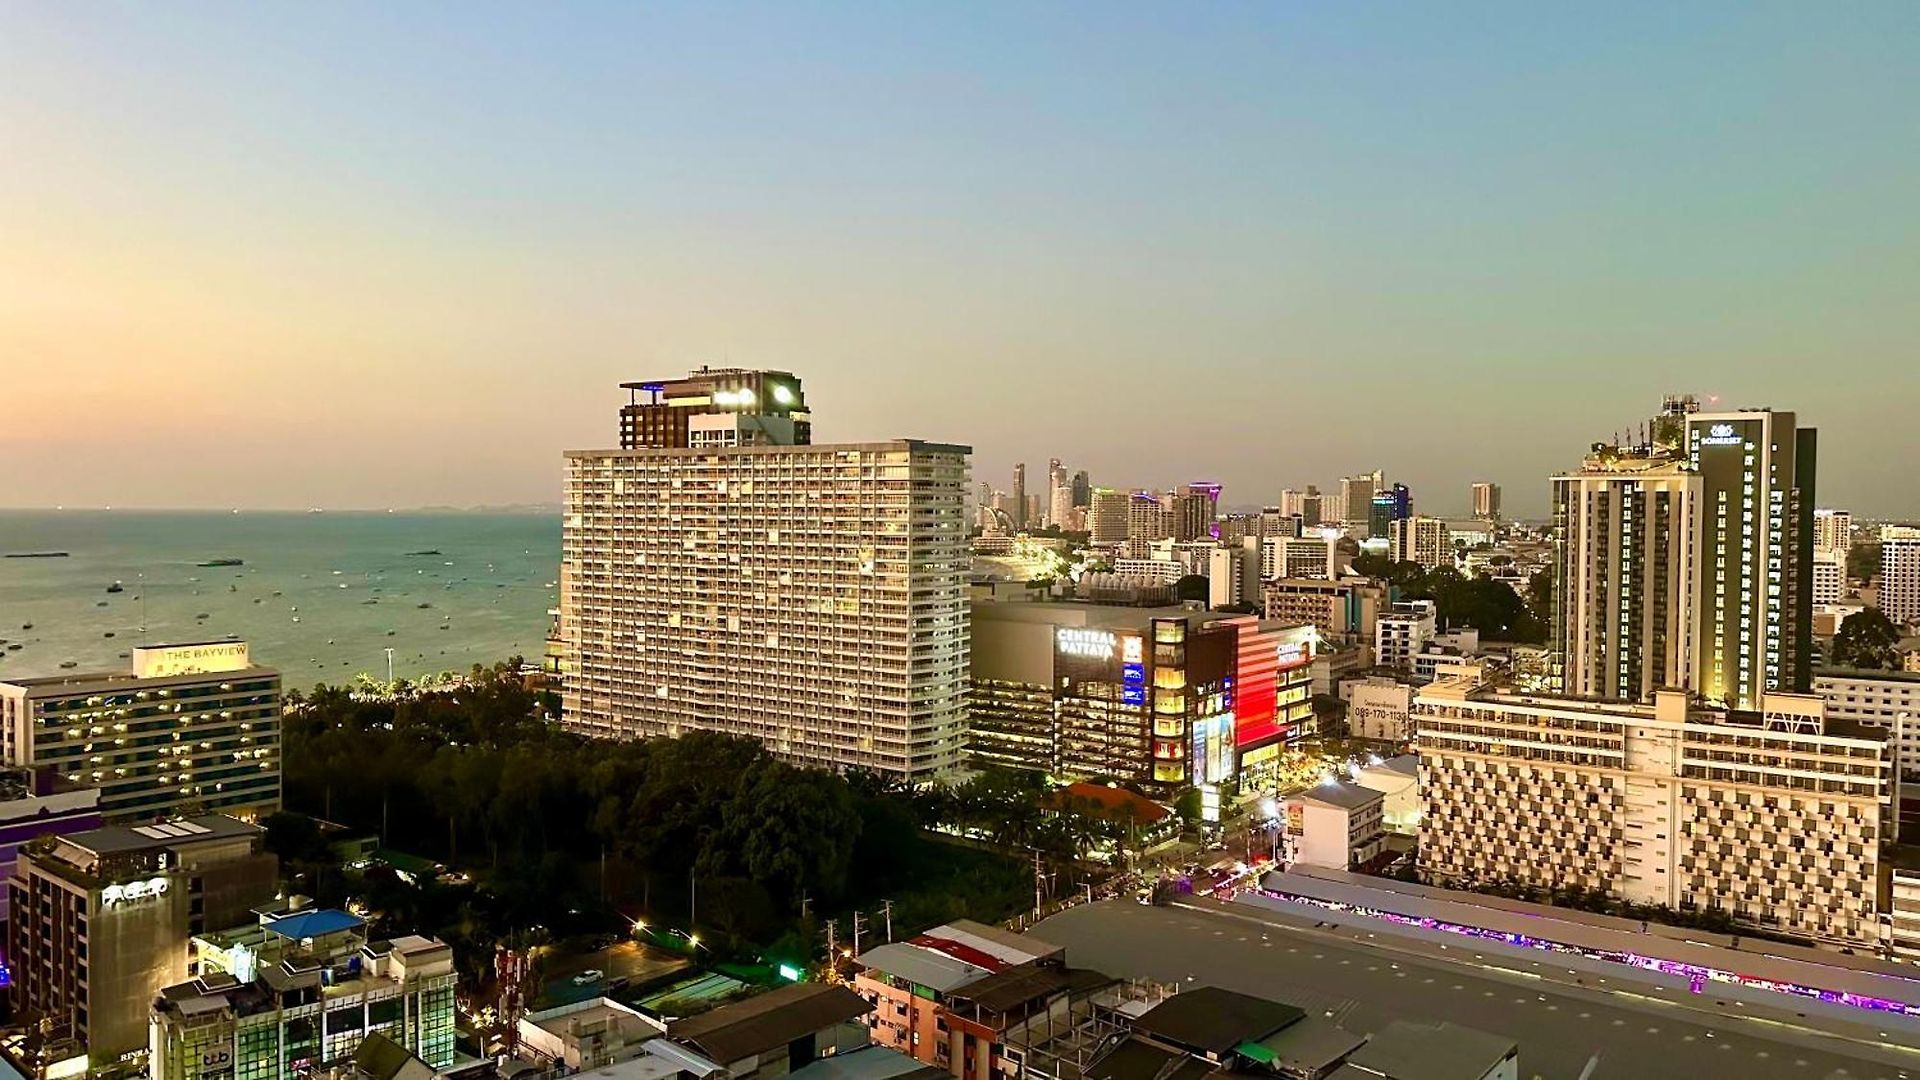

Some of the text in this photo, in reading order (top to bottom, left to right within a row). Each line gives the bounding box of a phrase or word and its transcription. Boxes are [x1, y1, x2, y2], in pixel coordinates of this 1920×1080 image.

[1057, 629, 1116, 645] CENTRAL
[166, 644, 246, 660] THE BAYVIEW
[1060, 641, 1114, 659] PATTAYA
